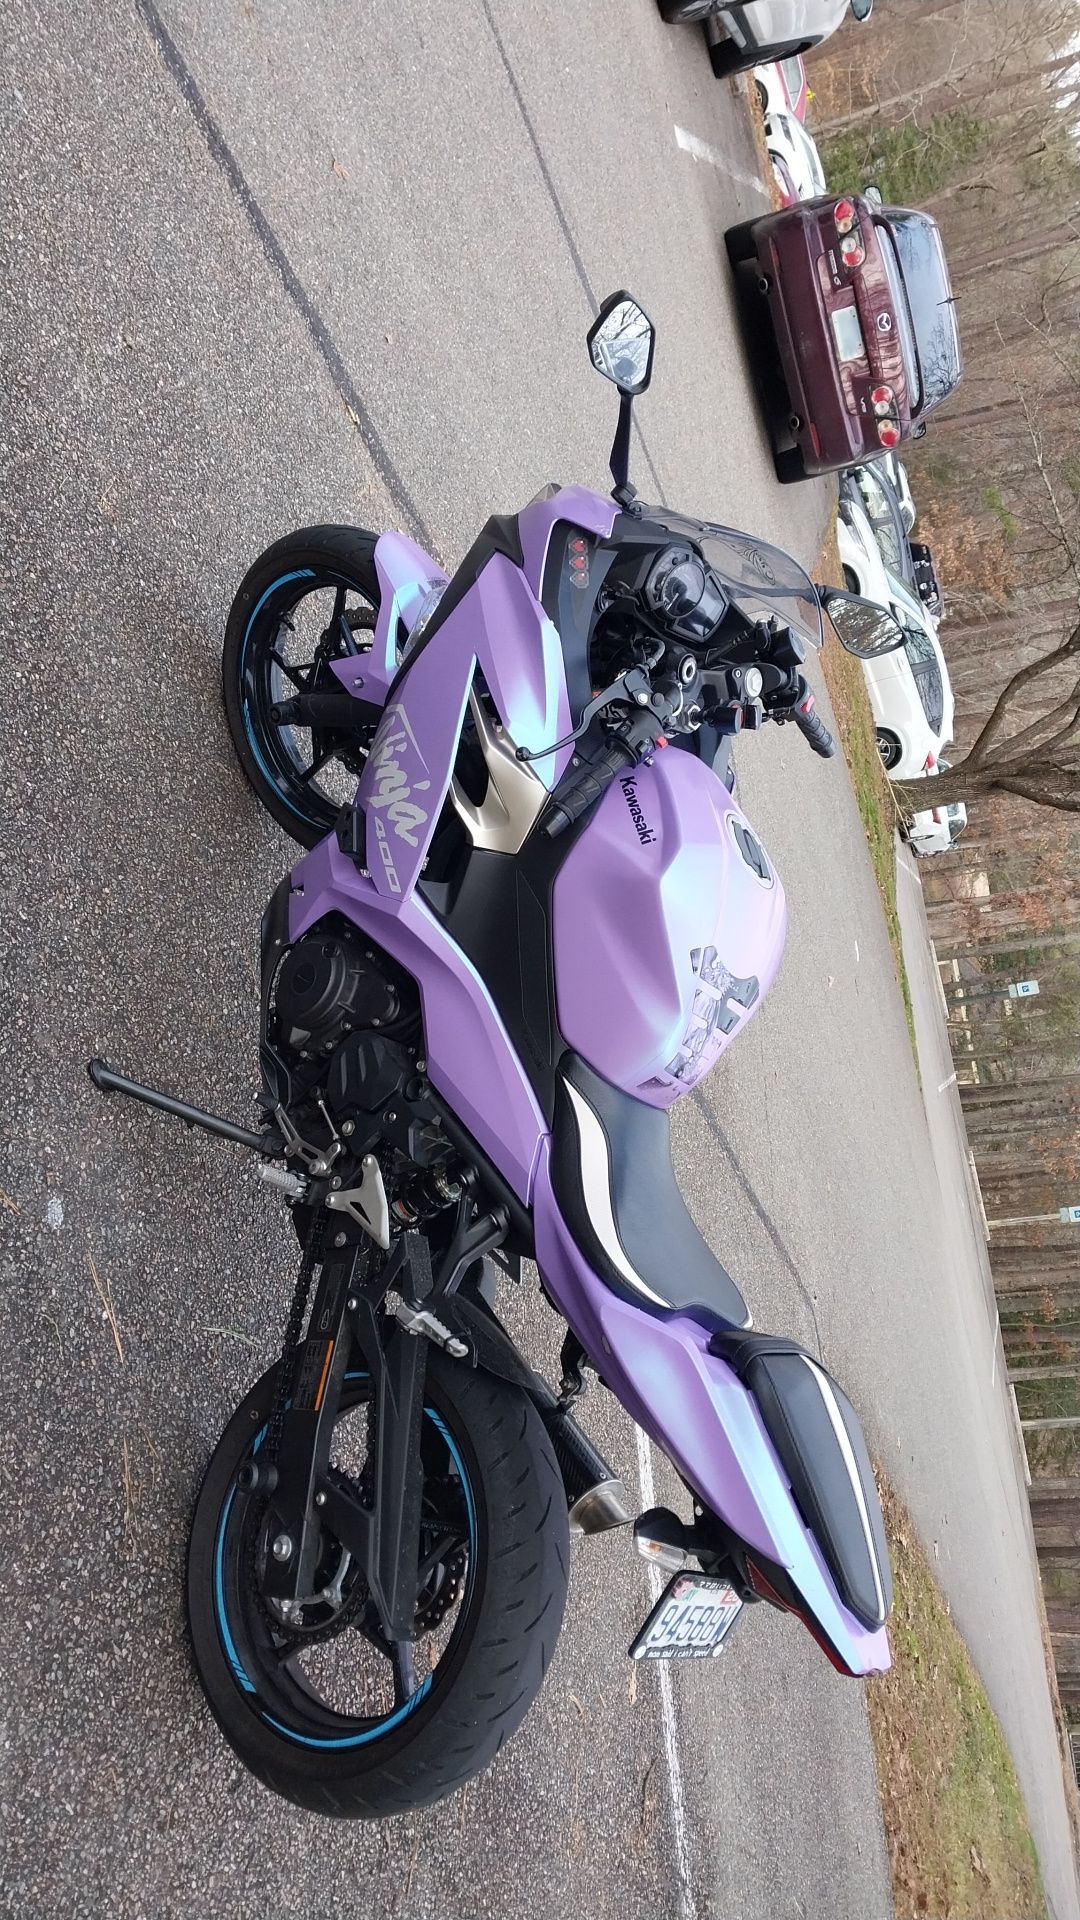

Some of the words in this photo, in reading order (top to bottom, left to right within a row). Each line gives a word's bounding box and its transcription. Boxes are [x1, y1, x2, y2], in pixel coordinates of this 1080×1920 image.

[367, 703, 431, 848] Ninja
[619, 775, 657, 845] Kawasaki
[374, 816, 402, 894] 400
